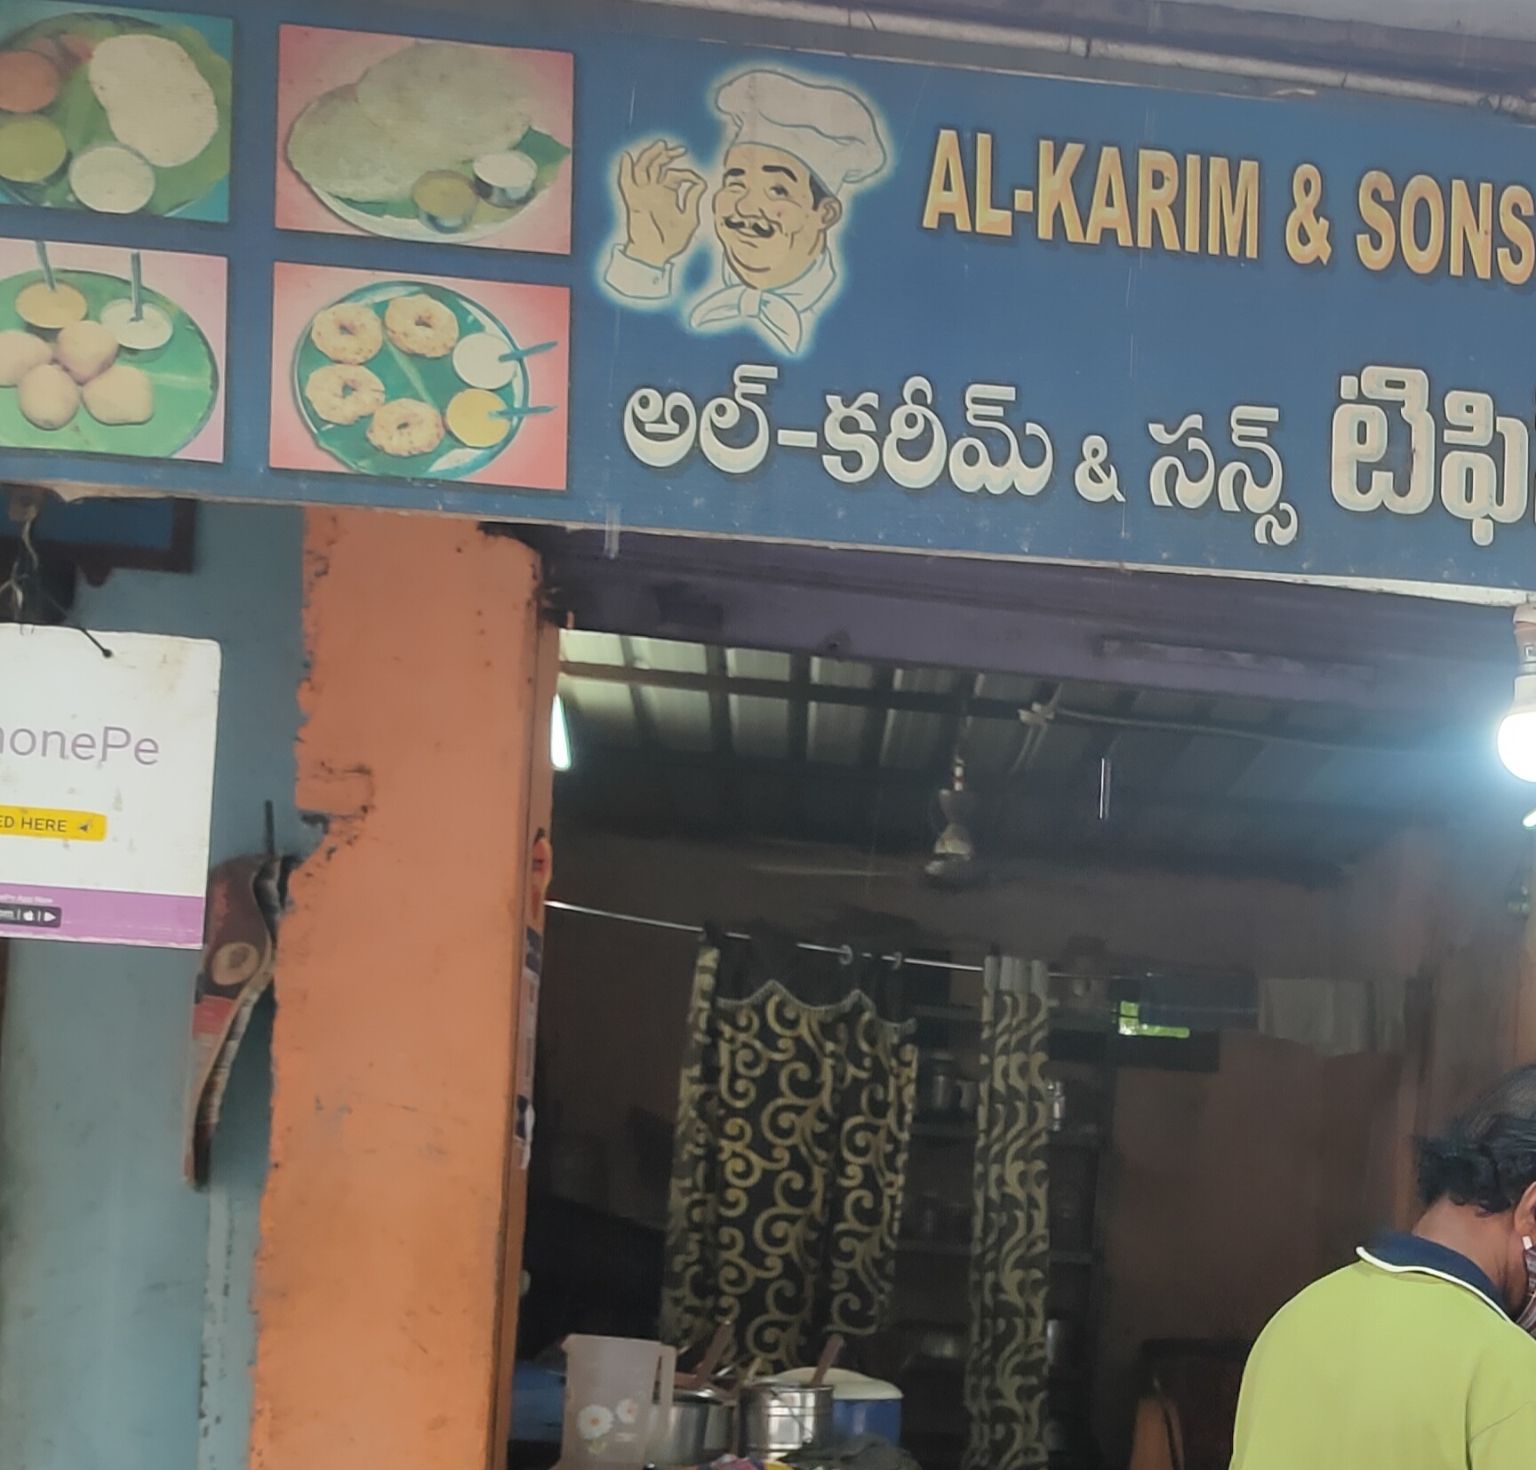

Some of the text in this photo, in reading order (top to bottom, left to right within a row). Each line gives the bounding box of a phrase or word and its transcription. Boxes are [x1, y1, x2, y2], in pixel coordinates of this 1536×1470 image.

[922, 128, 1261, 260] AL-KARIM
[1284, 162, 1334, 267] &
[622, 363, 1054, 497] అల్-కరీమ్
[1074, 434, 1127, 504] &
[21, 817, 68, 834] HERE
